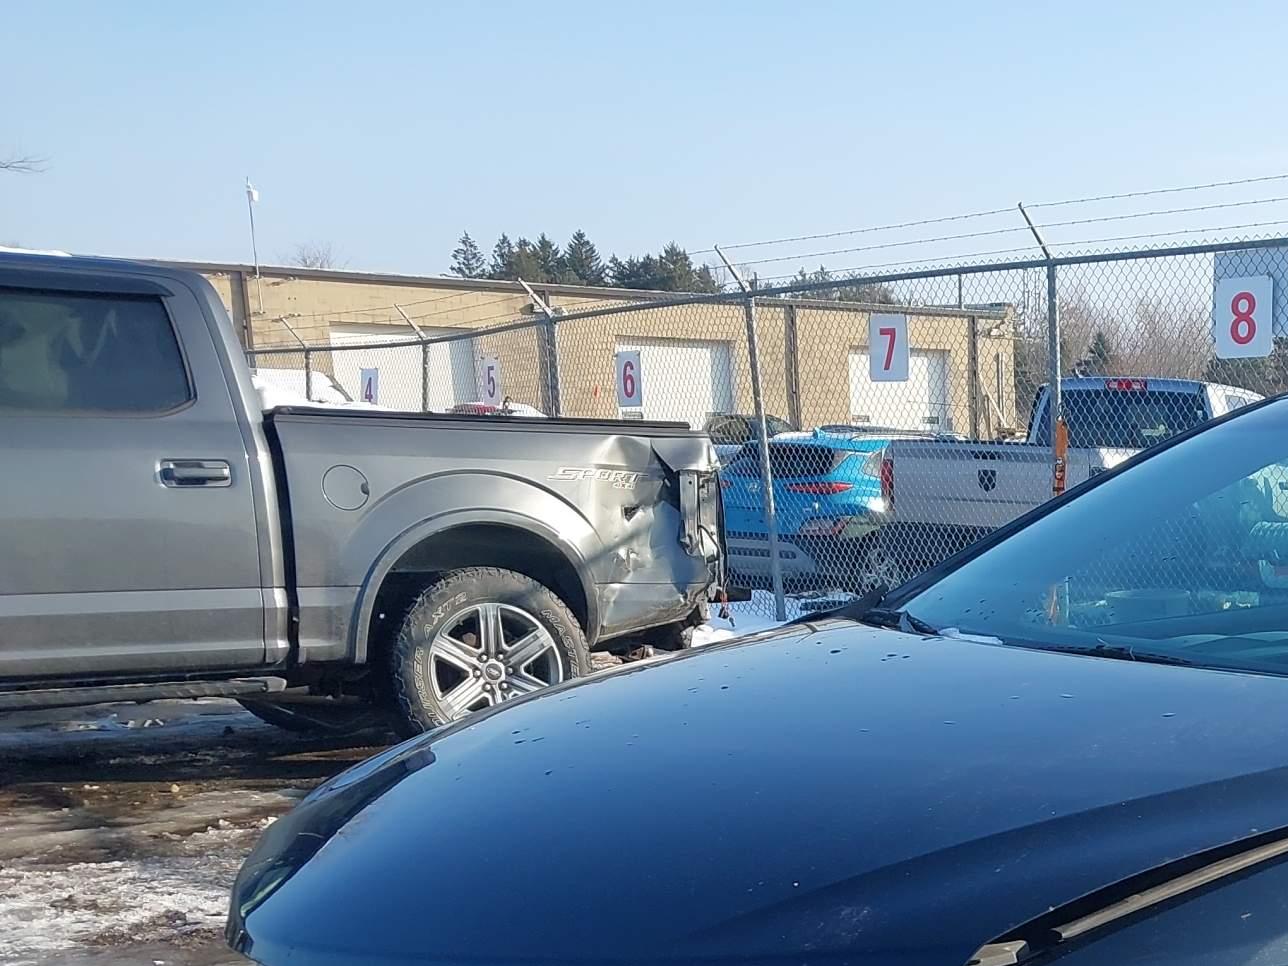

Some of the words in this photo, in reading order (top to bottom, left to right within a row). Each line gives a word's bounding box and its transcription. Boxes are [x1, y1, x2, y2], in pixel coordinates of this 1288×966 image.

[1229, 291, 1257, 345] 8
[878, 327, 896, 370] 7
[364, 376, 374, 402] 4
[486, 365, 497, 399] 5
[622, 360, 636, 398] 6
[547, 466, 648, 481] SPORT
